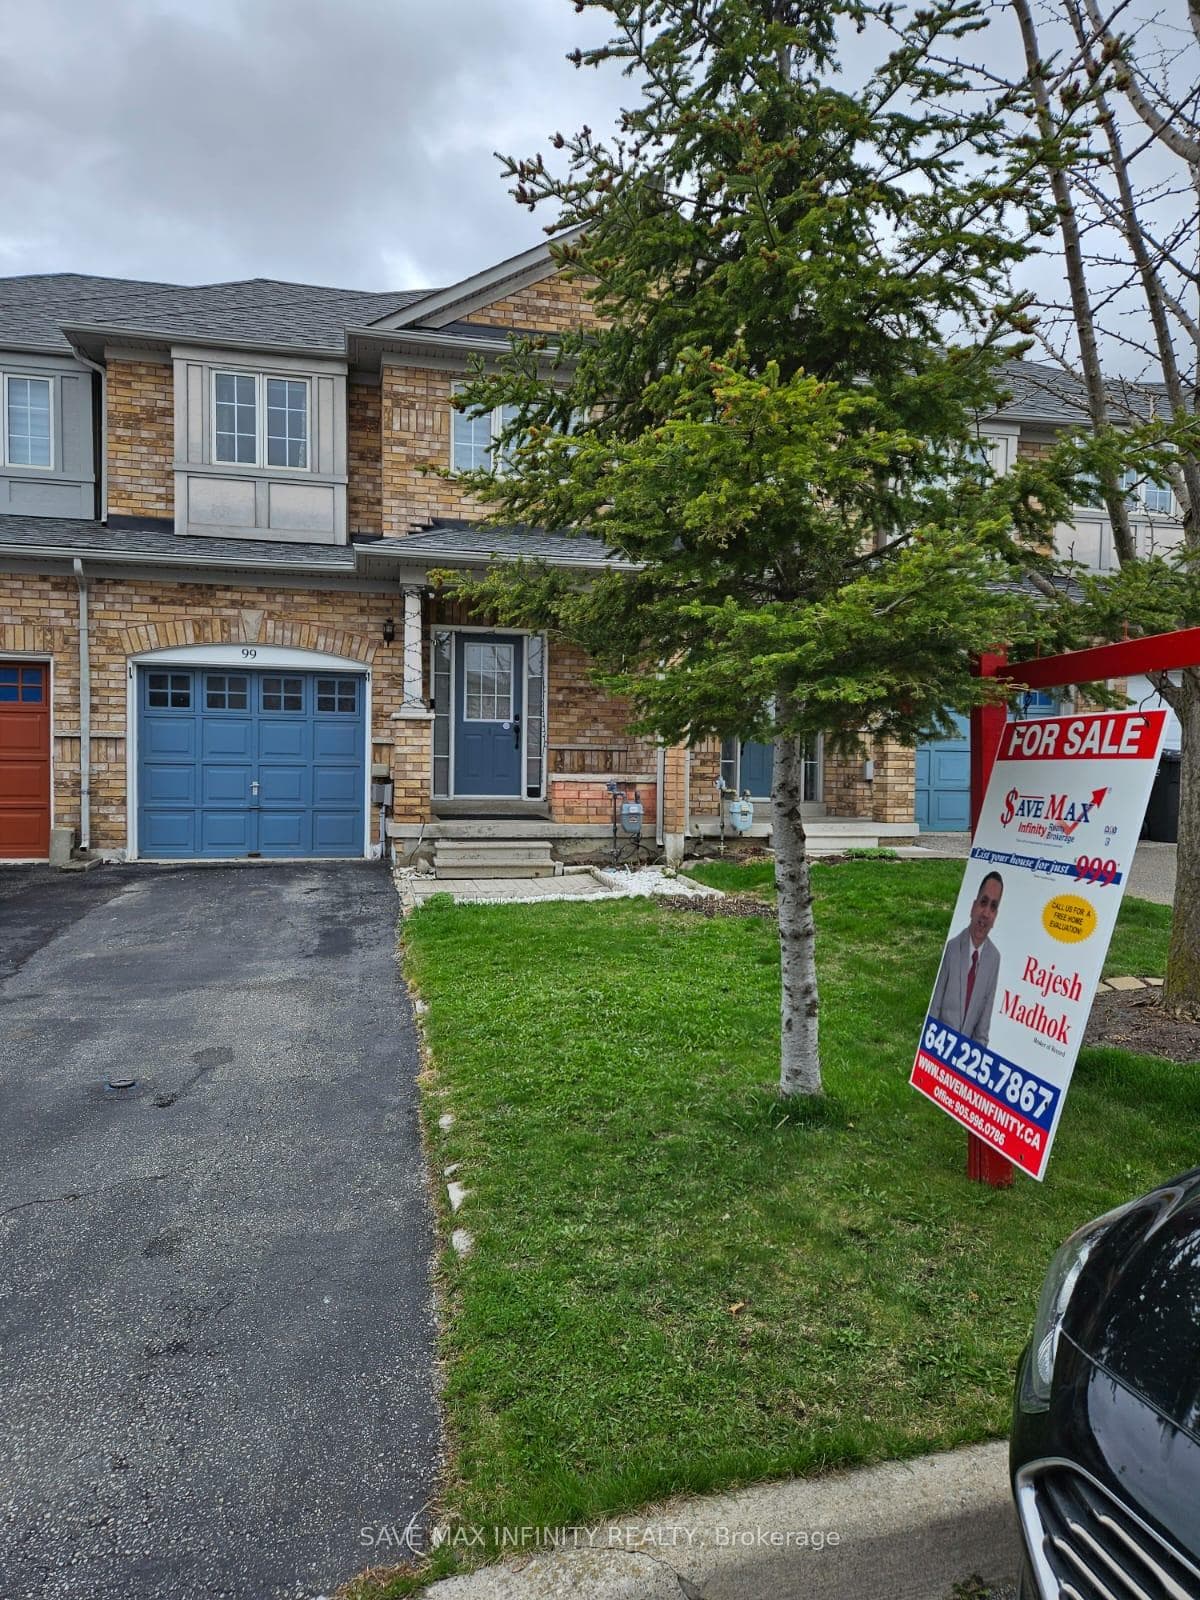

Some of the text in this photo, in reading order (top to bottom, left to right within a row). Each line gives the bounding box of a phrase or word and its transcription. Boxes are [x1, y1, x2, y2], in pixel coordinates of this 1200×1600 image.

[241, 648, 257, 659] 99
[1008, 717, 1147, 757] FOR SALE
[1018, 821, 1047, 837] Infinity
[1046, 831, 1075, 844] Brokerage
[974, 848, 990, 859] List
[990, 852, 1012, 864] your
[1009, 853, 1034, 868] house
[1031, 857, 1049, 872] for
[1048, 860, 1069, 875] just
[1021, 955, 1082, 1001] Rajesh
[999, 990, 1072, 1045] Madhok
[924, 1022, 1054, 1119] 647.225.7867
[918, 1054, 1041, 1151] WWW.SAVEMAXINFINITY.CA
[933, 1085, 1006, 1146] Office: 905.996.0786
